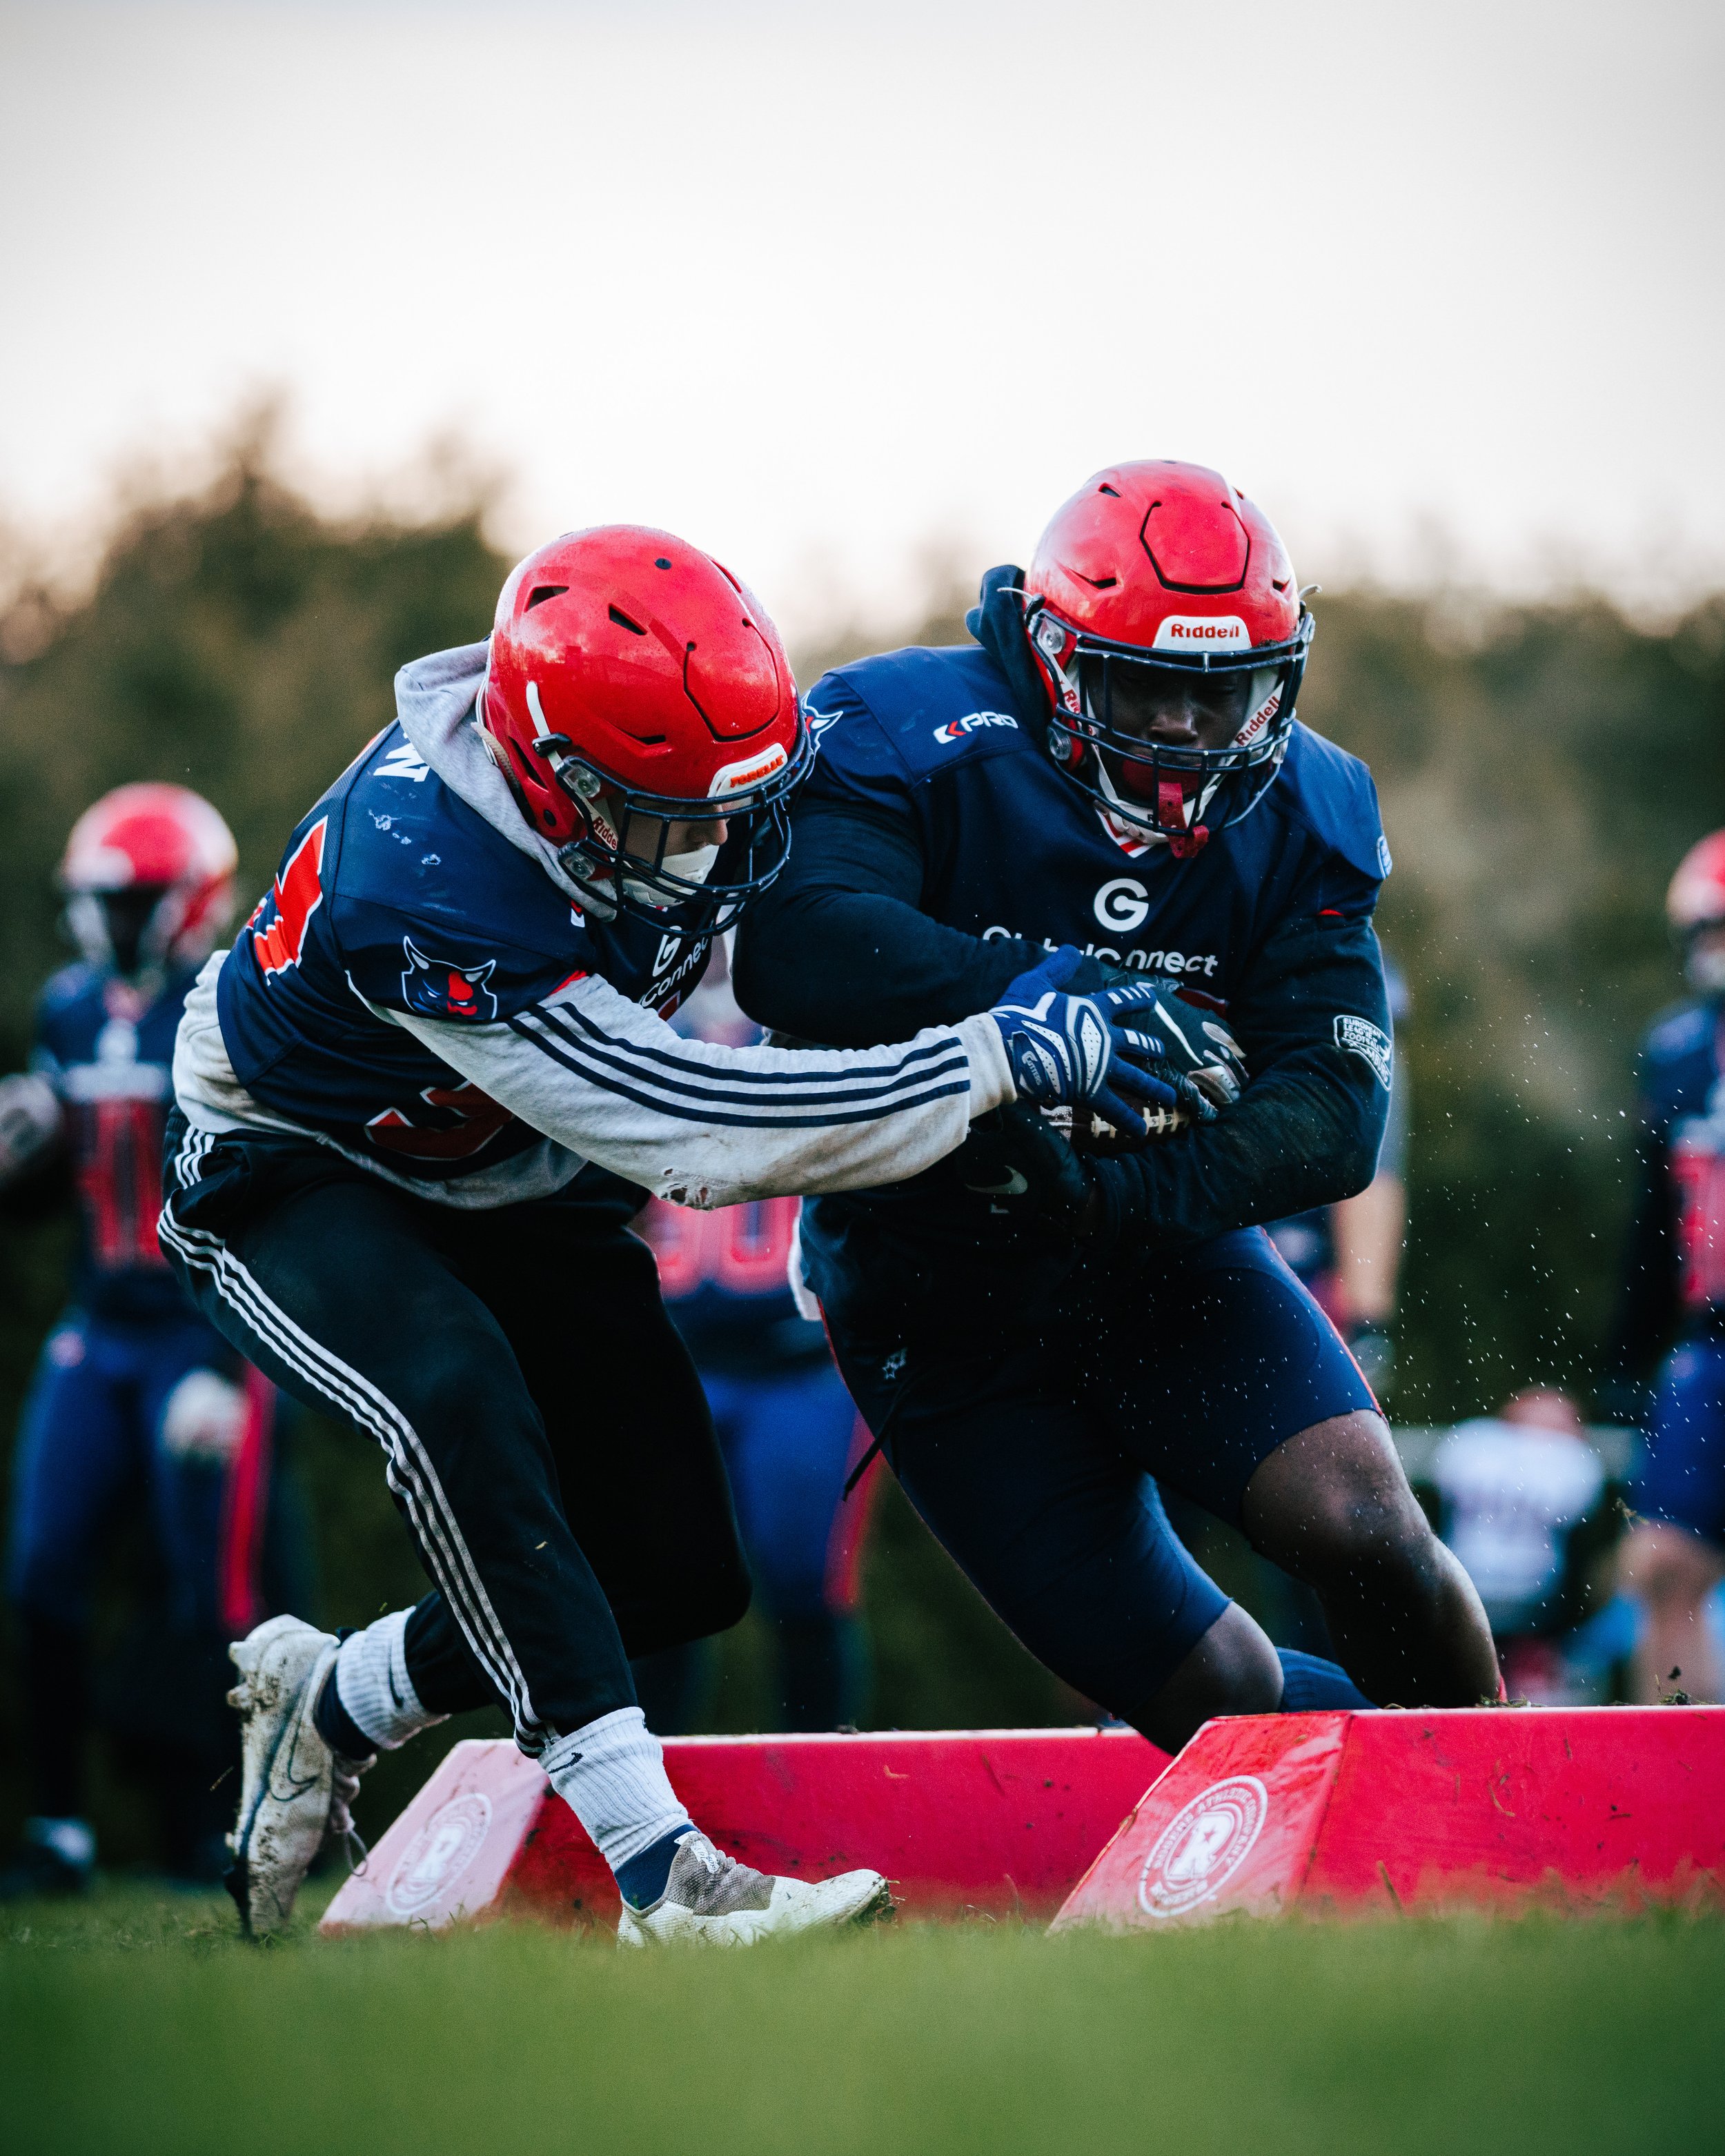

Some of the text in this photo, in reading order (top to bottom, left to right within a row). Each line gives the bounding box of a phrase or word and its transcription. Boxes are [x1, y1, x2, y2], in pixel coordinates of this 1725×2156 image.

[1171, 624, 1239, 638] Riddell
[1234, 695, 1280, 746] Riddell
[593, 815, 617, 849] Ridde
[1094, 878, 1149, 931] G
